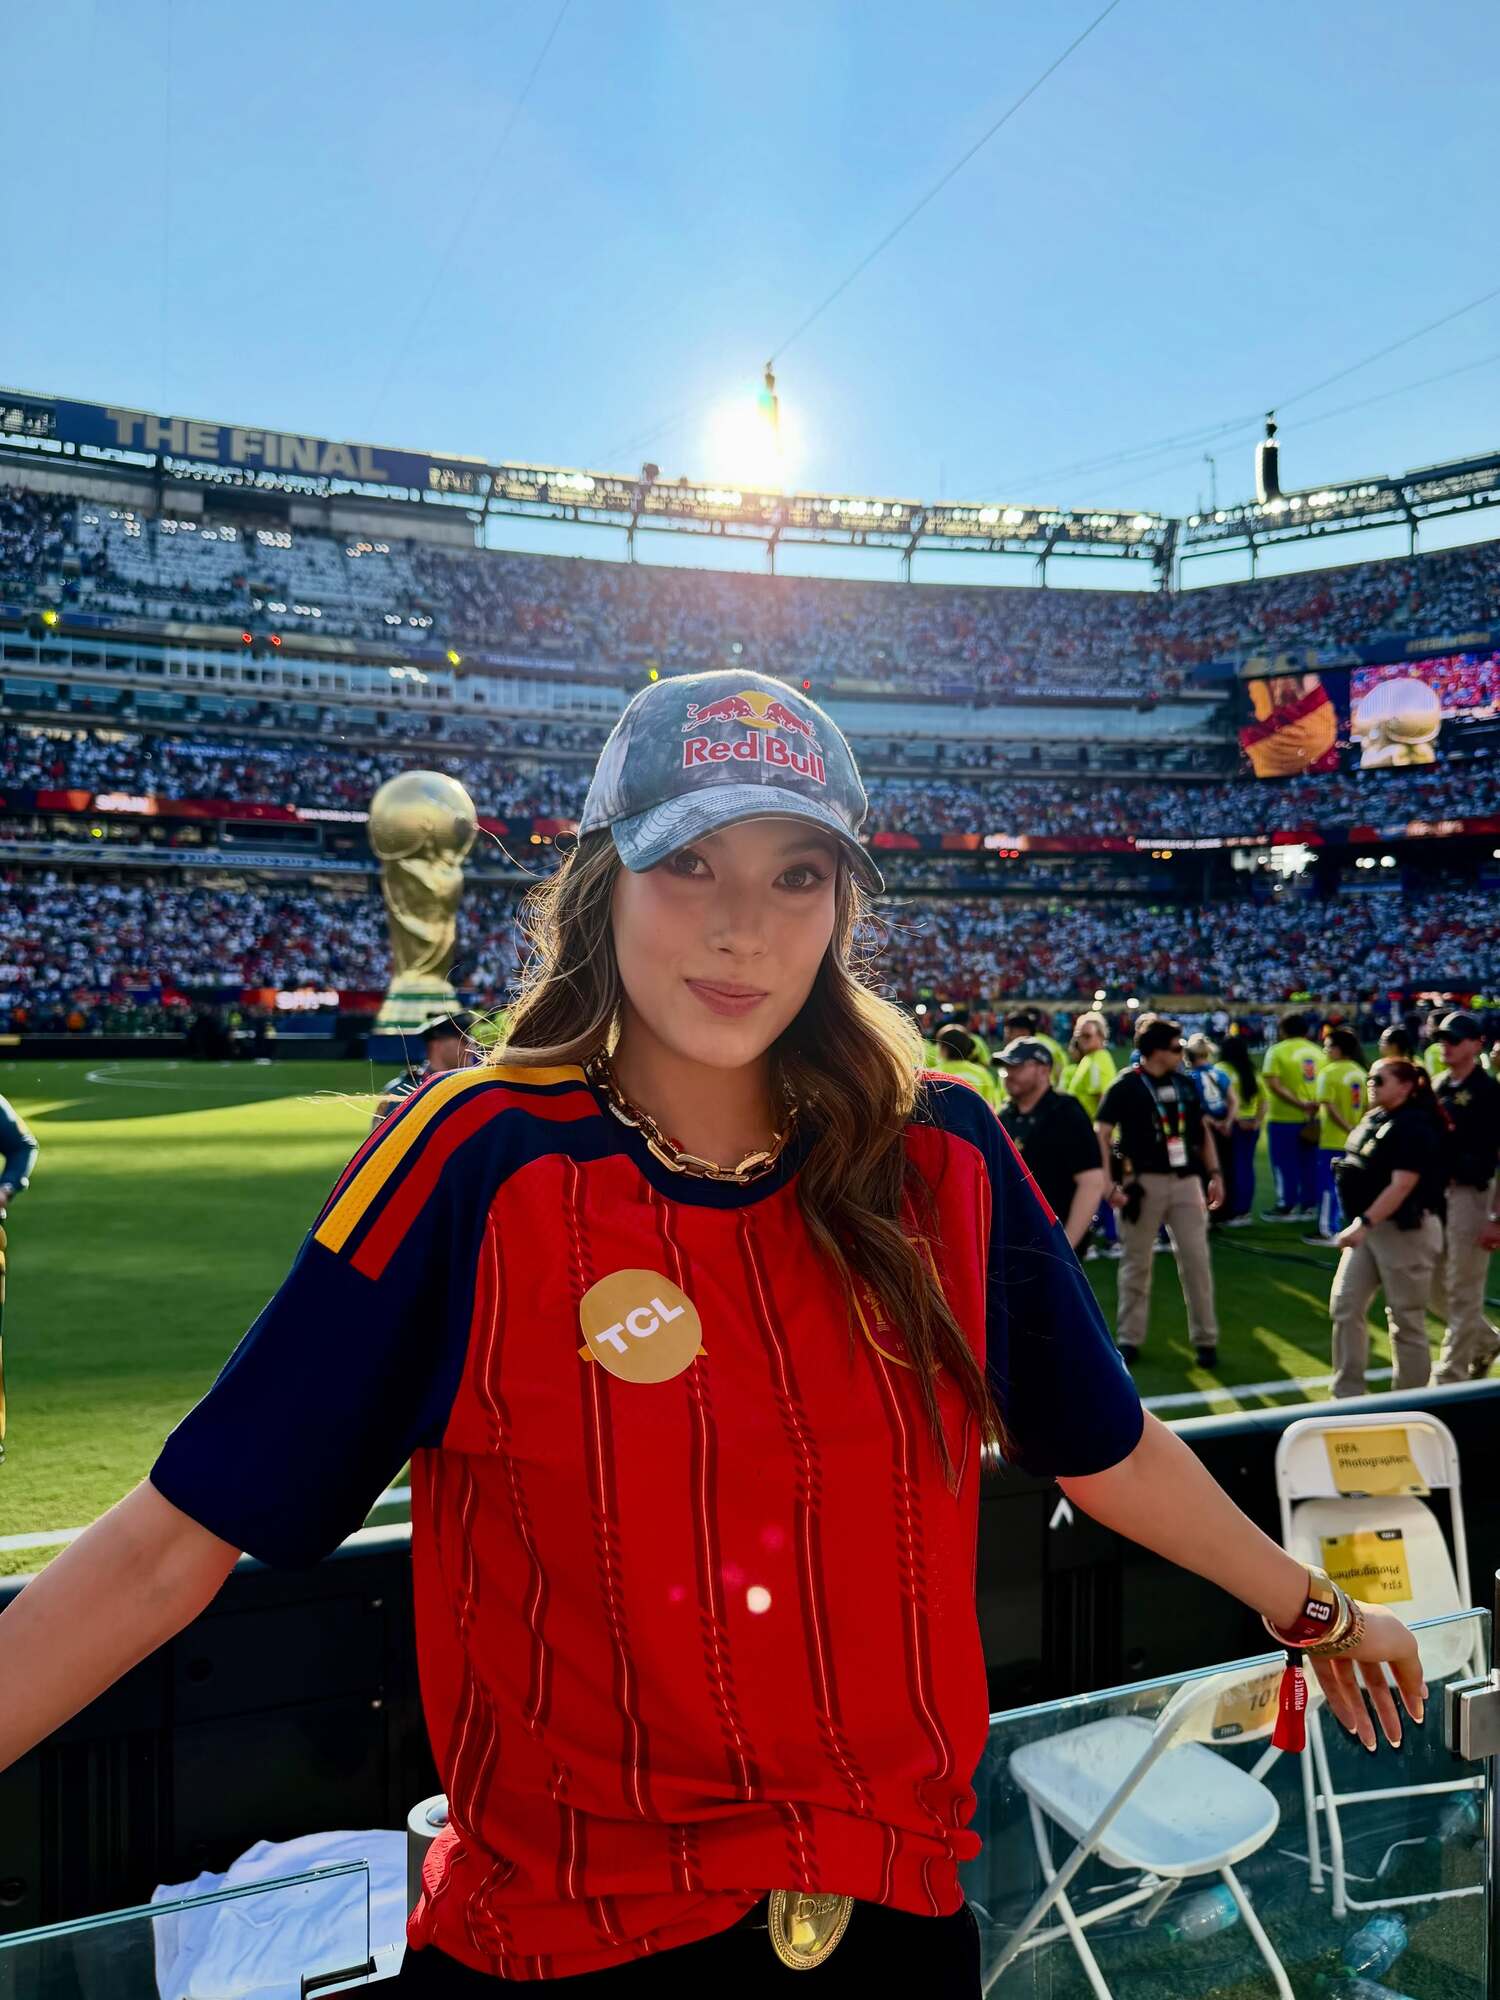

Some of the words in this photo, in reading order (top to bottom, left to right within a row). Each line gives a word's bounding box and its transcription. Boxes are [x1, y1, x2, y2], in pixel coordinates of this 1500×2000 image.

[106, 408, 220, 458] THE
[230, 429, 389, 481] FINAL
[682, 731, 760, 769] Red
[763, 734, 828, 785] Bull
[594, 1297, 686, 1354] TCL
[1334, 1442, 1358, 1454] FIFA
[1294, 1679, 1305, 1711] PRIVATE
